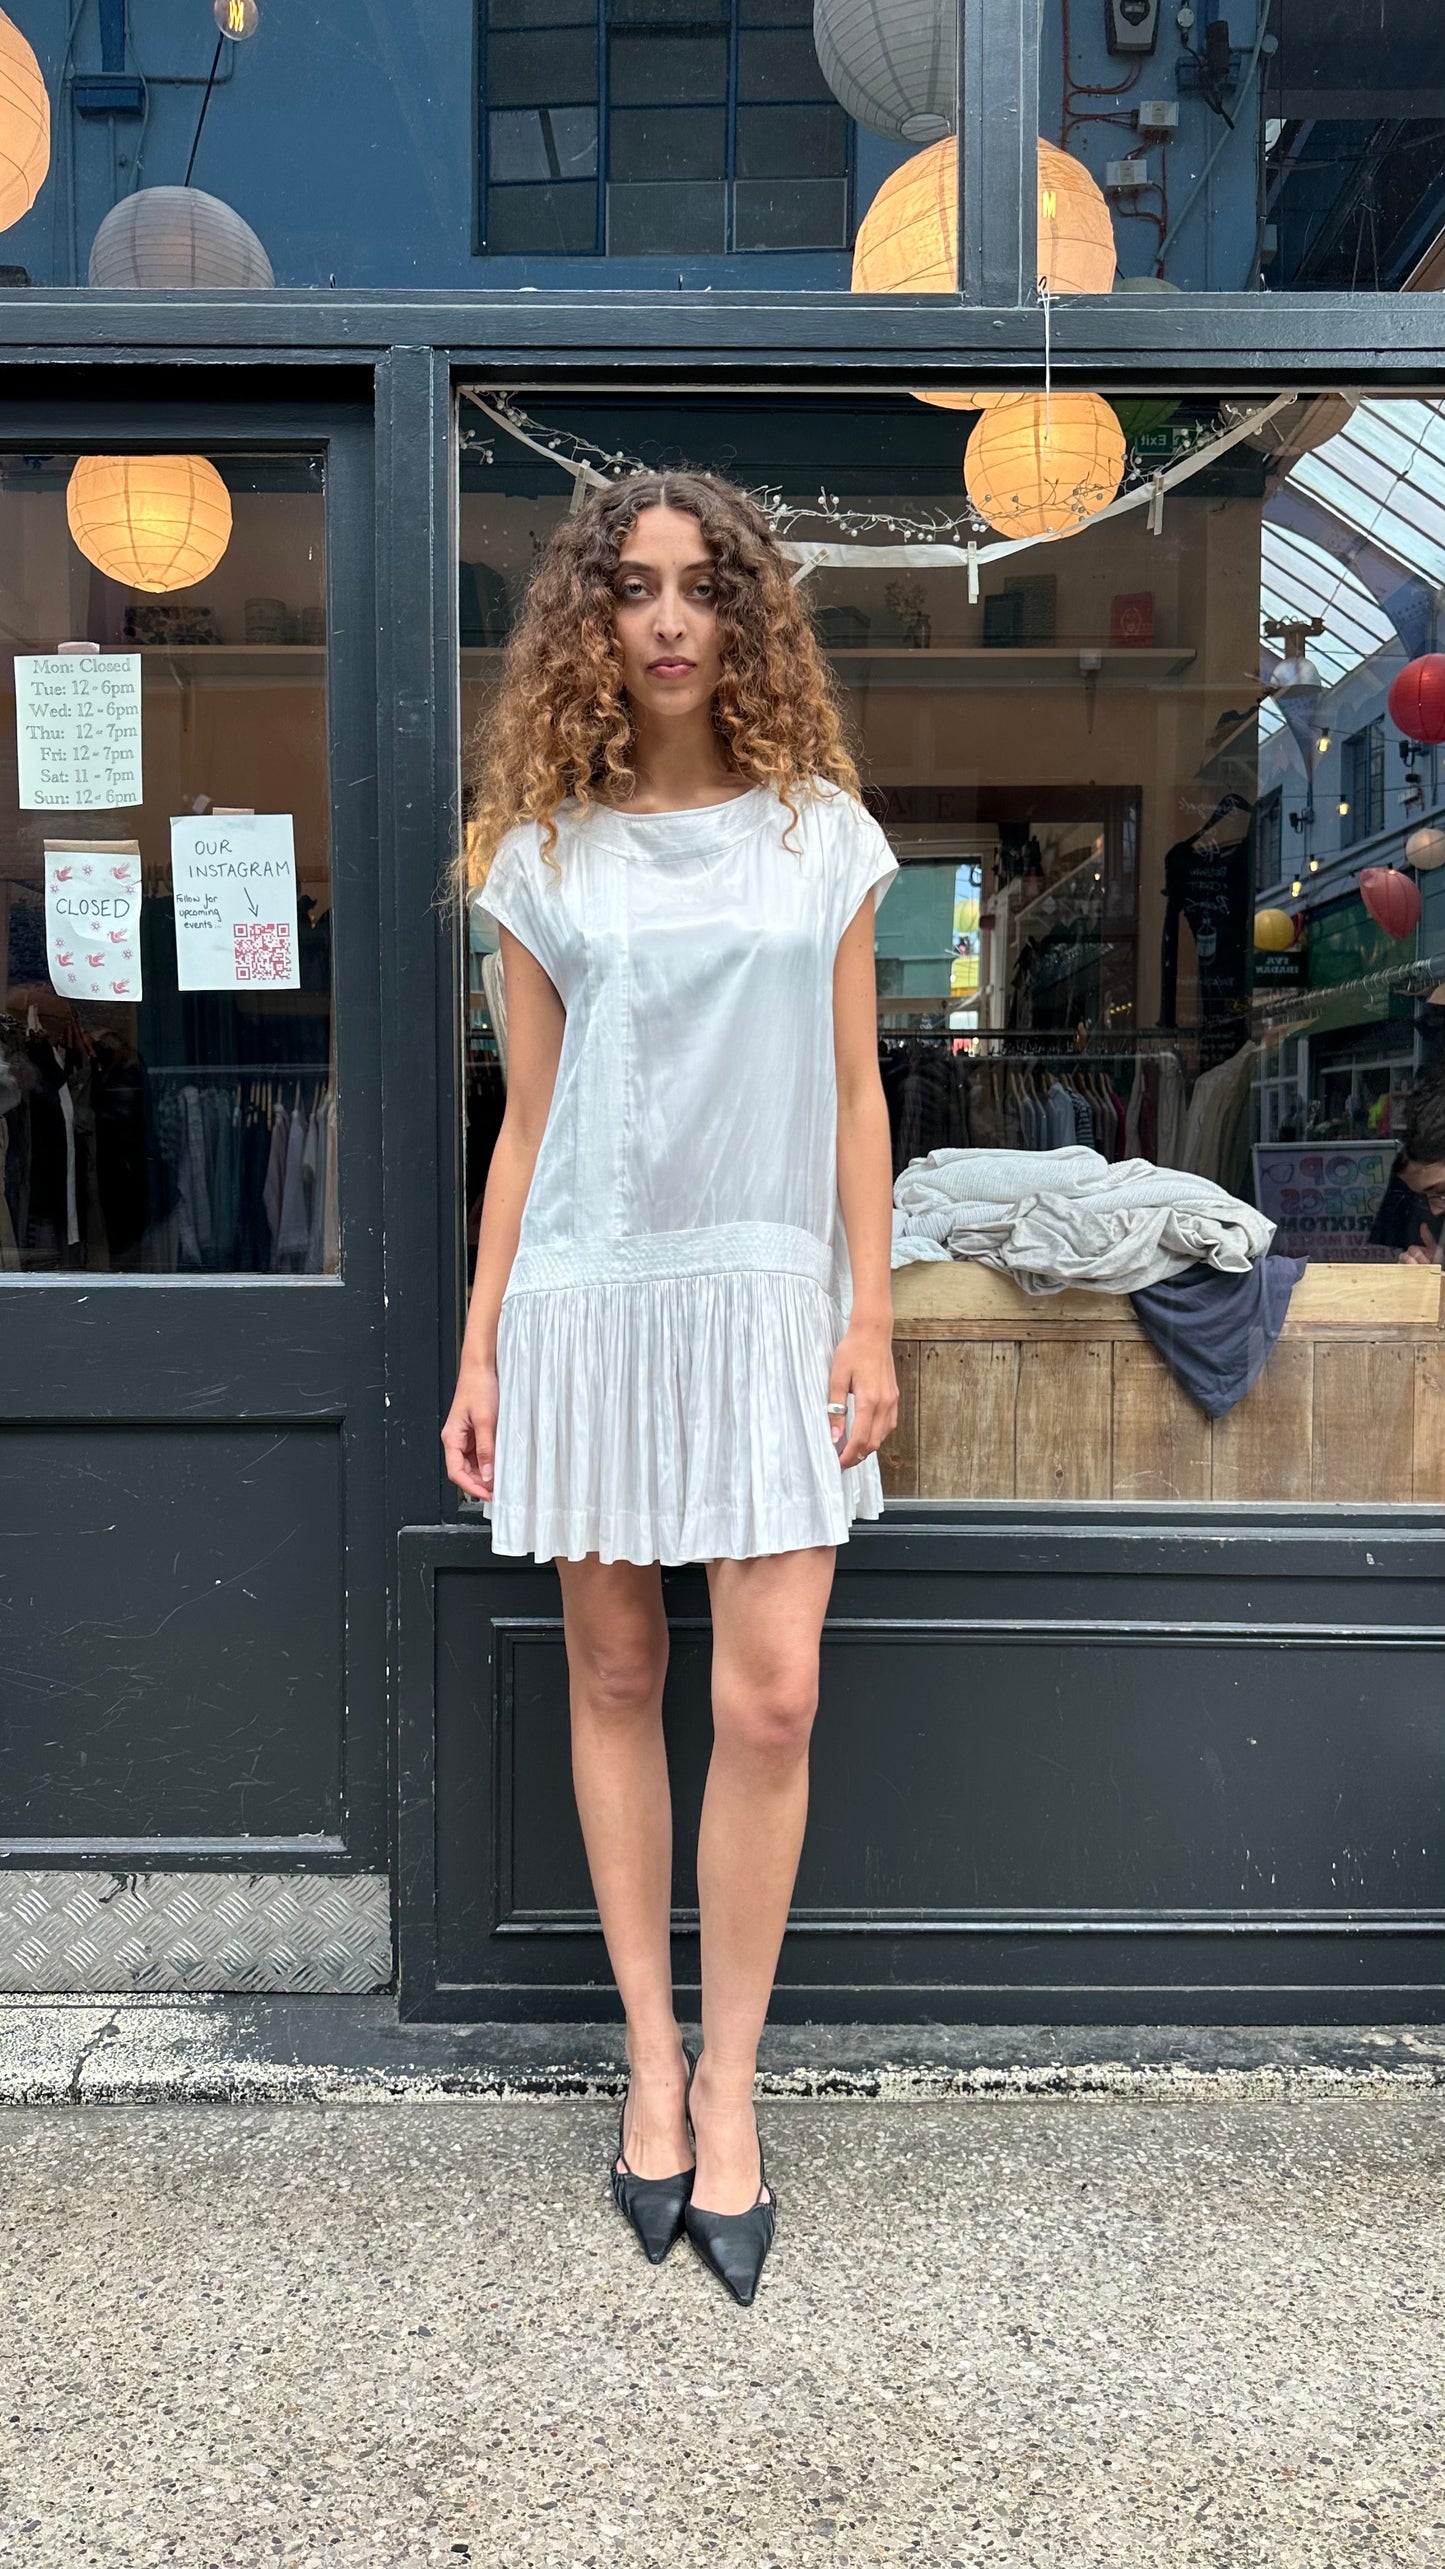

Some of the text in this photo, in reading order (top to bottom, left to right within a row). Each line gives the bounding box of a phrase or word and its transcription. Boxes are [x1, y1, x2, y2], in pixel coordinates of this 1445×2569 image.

[33, 658, 131, 674] Mon: Closed
[31, 681, 66, 695] Tue:
[72, 680, 89, 695] 12
[101, 680, 135, 698] 6pm
[28, 703, 72, 717] Wed:
[77, 702, 94, 717] 12
[106, 702, 139, 720] 6pm
[26, 725, 65, 740] Thu:
[75, 723, 93, 739] 12
[106, 723, 138, 742] 7pm
[40, 747, 67, 761] Fri:
[73, 745, 89, 761] 12
[103, 746, 134, 764] 7pm
[40, 769, 69, 783] Sat:
[75, 769, 88, 783] 11
[104, 768, 135, 785] 7pm
[34, 790, 70, 805] Sun:
[75, 789, 93, 805] 12
[106, 789, 137, 806] 6pm
[195, 839, 232, 855] OUR
[189, 861, 290, 878] INSTAGRAM
[56, 898, 130, 918] CLOSED
[176, 894, 218, 909] Follow for
[179, 908, 222, 922] upcoming
